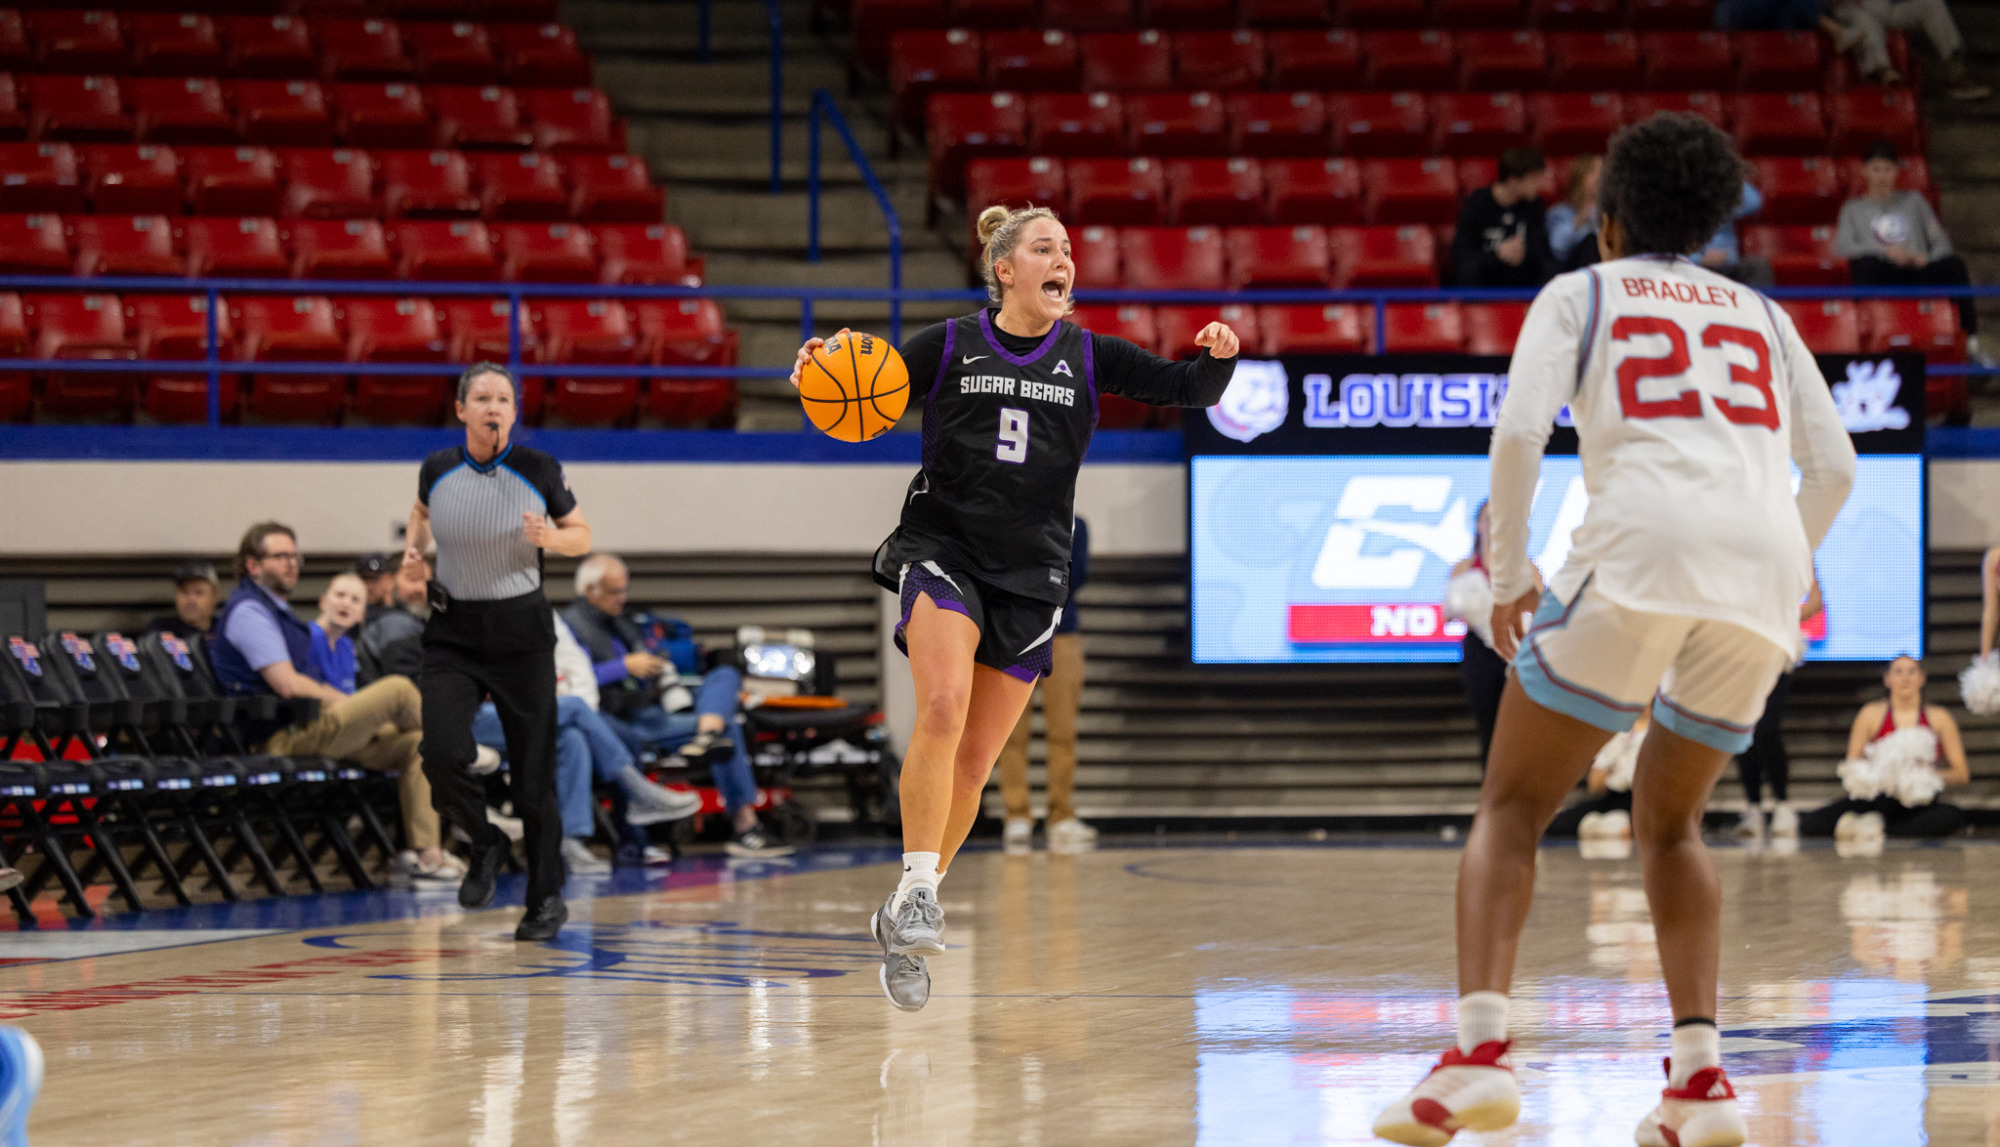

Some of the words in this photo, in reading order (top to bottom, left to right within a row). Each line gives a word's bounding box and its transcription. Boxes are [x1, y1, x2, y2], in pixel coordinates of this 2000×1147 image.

[1621, 277, 1739, 309] BRADLEY
[960, 375, 1016, 395] SUGAR
[1020, 379, 1075, 407] BEARS
[1611, 315, 1782, 433] 23
[1303, 374, 1509, 427] LOUISI
[995, 407, 1029, 464] 9
[1370, 605, 1438, 636] NO
